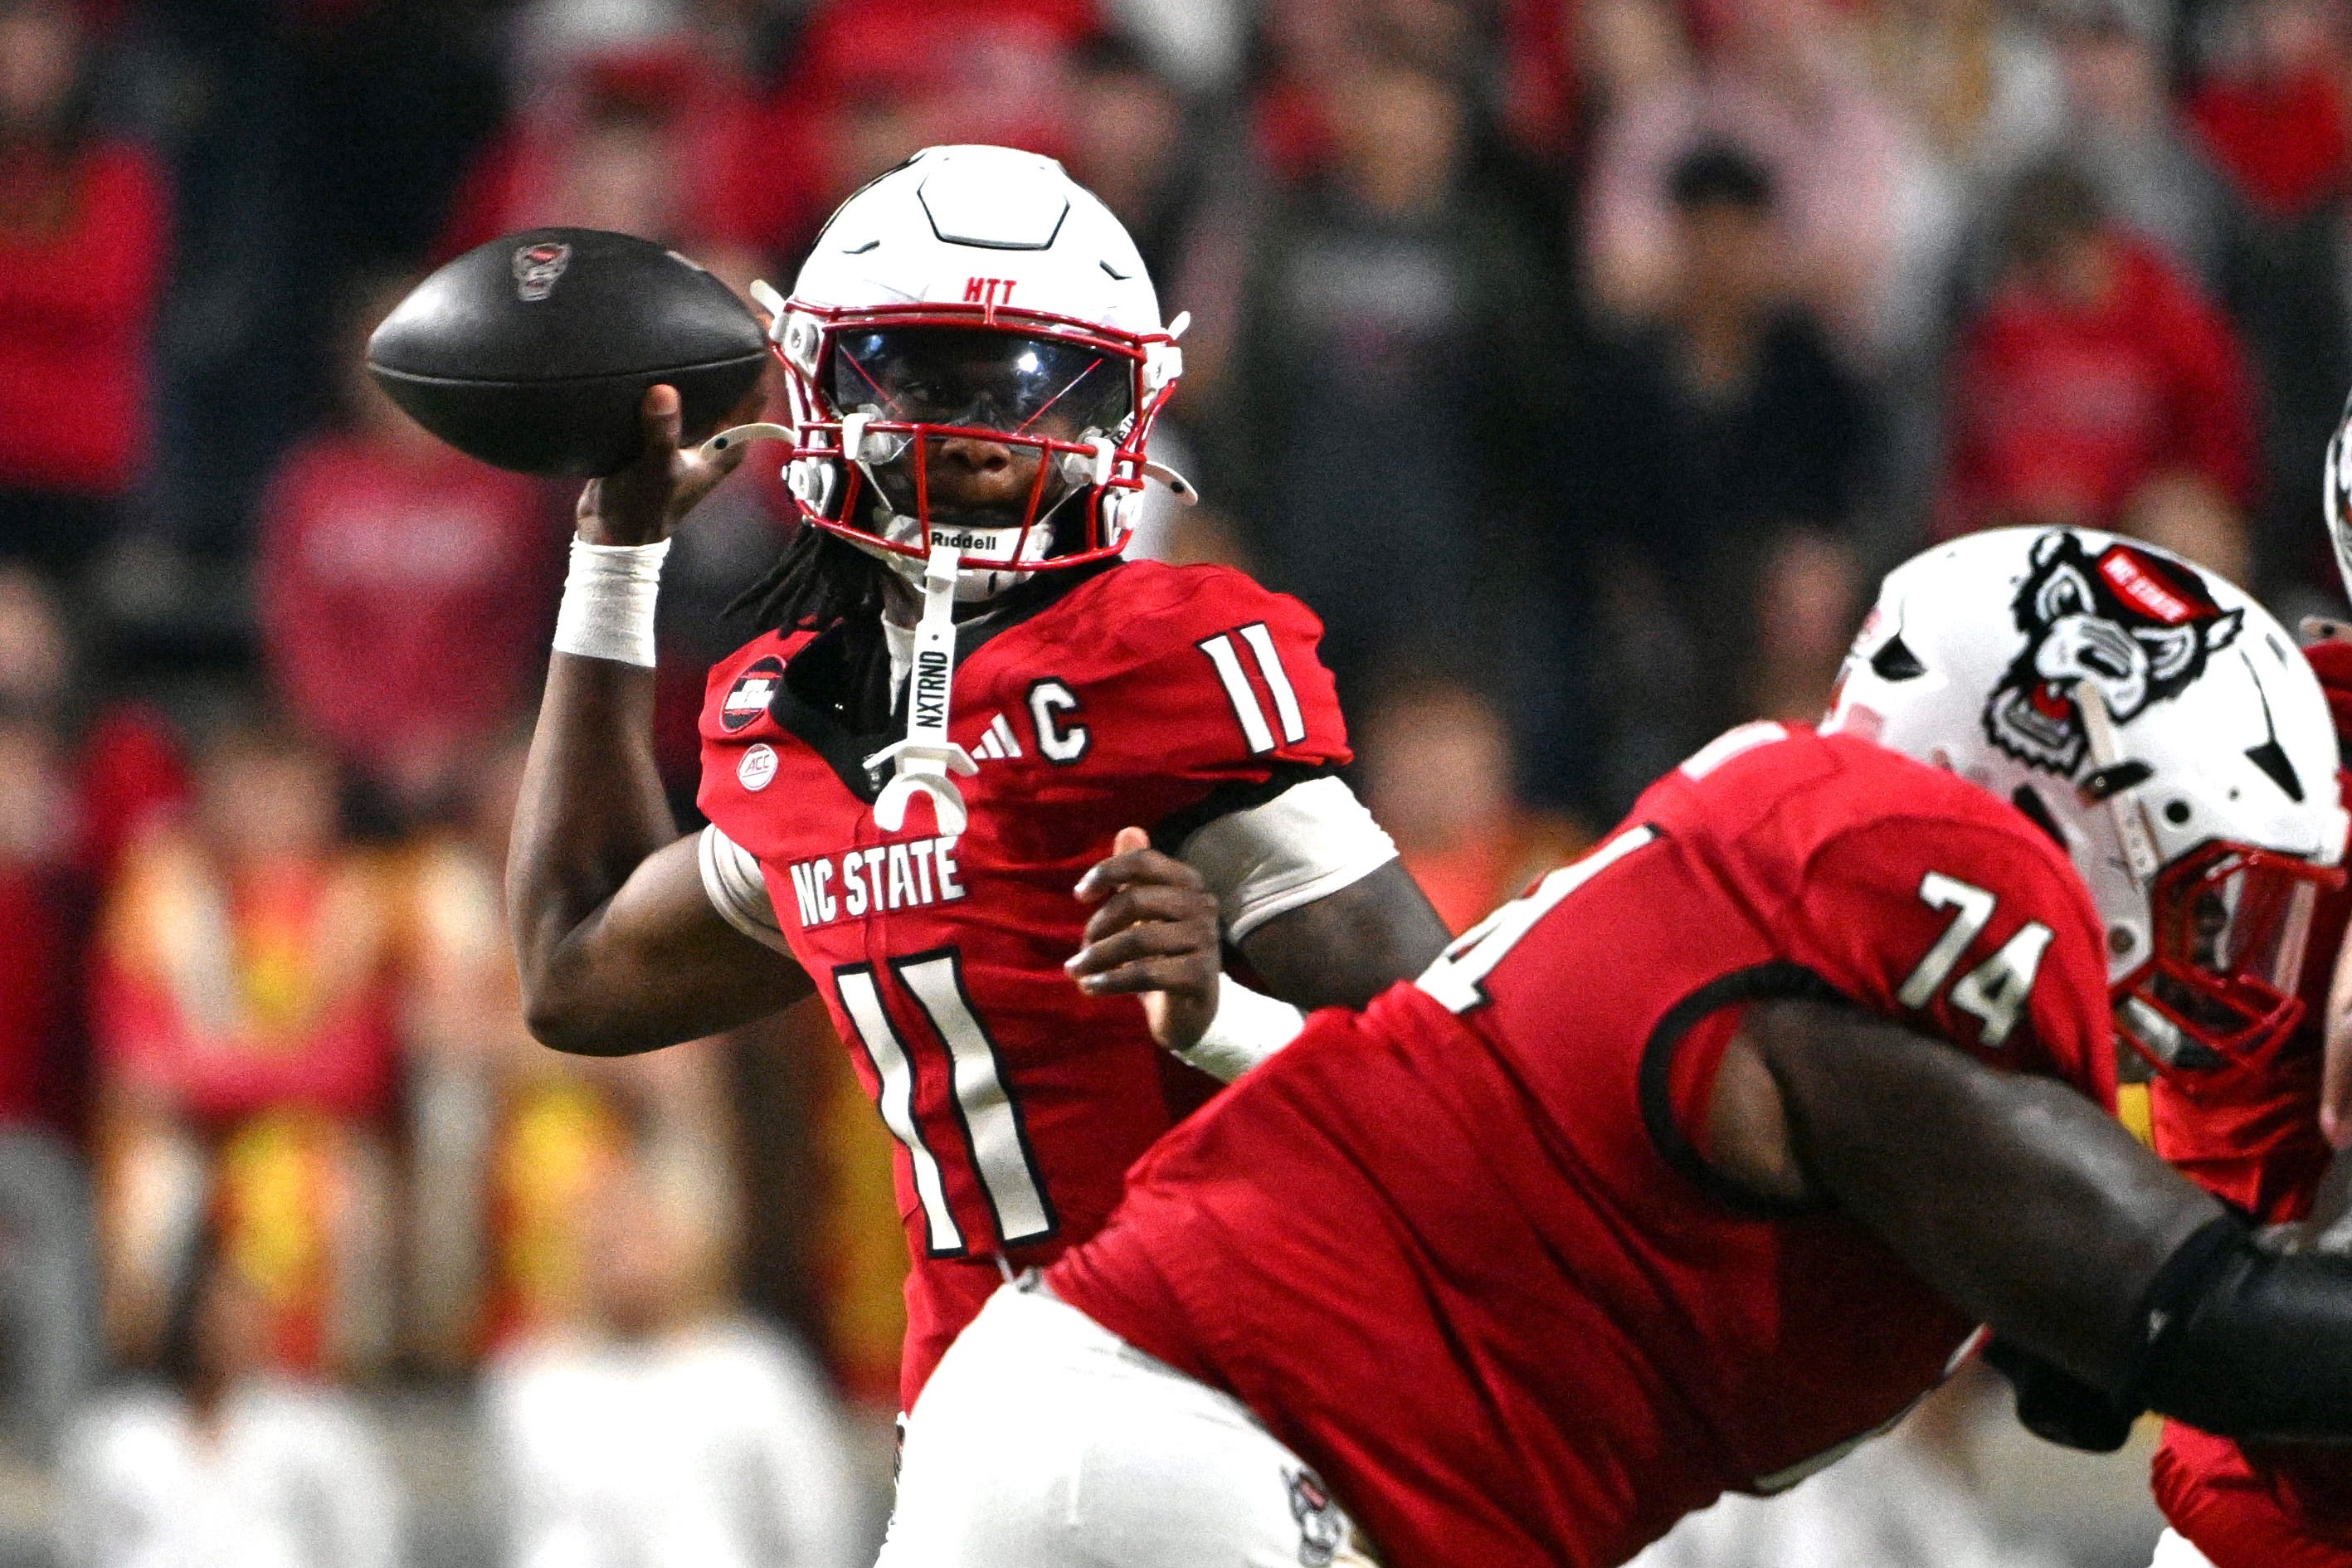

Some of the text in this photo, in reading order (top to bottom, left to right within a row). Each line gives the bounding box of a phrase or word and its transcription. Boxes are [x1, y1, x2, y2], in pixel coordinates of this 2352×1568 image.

[962, 276, 1017, 304] HTT
[930, 531, 996, 550] Riddell
[916, 650, 947, 728] NXTRND
[1027, 679, 1088, 763] C
[1195, 621, 1307, 756] 11
[744, 754, 770, 773] ACC
[790, 835, 967, 927] NC STATE
[1898, 871, 2055, 1047] 74
[834, 947, 1058, 1256] 11
